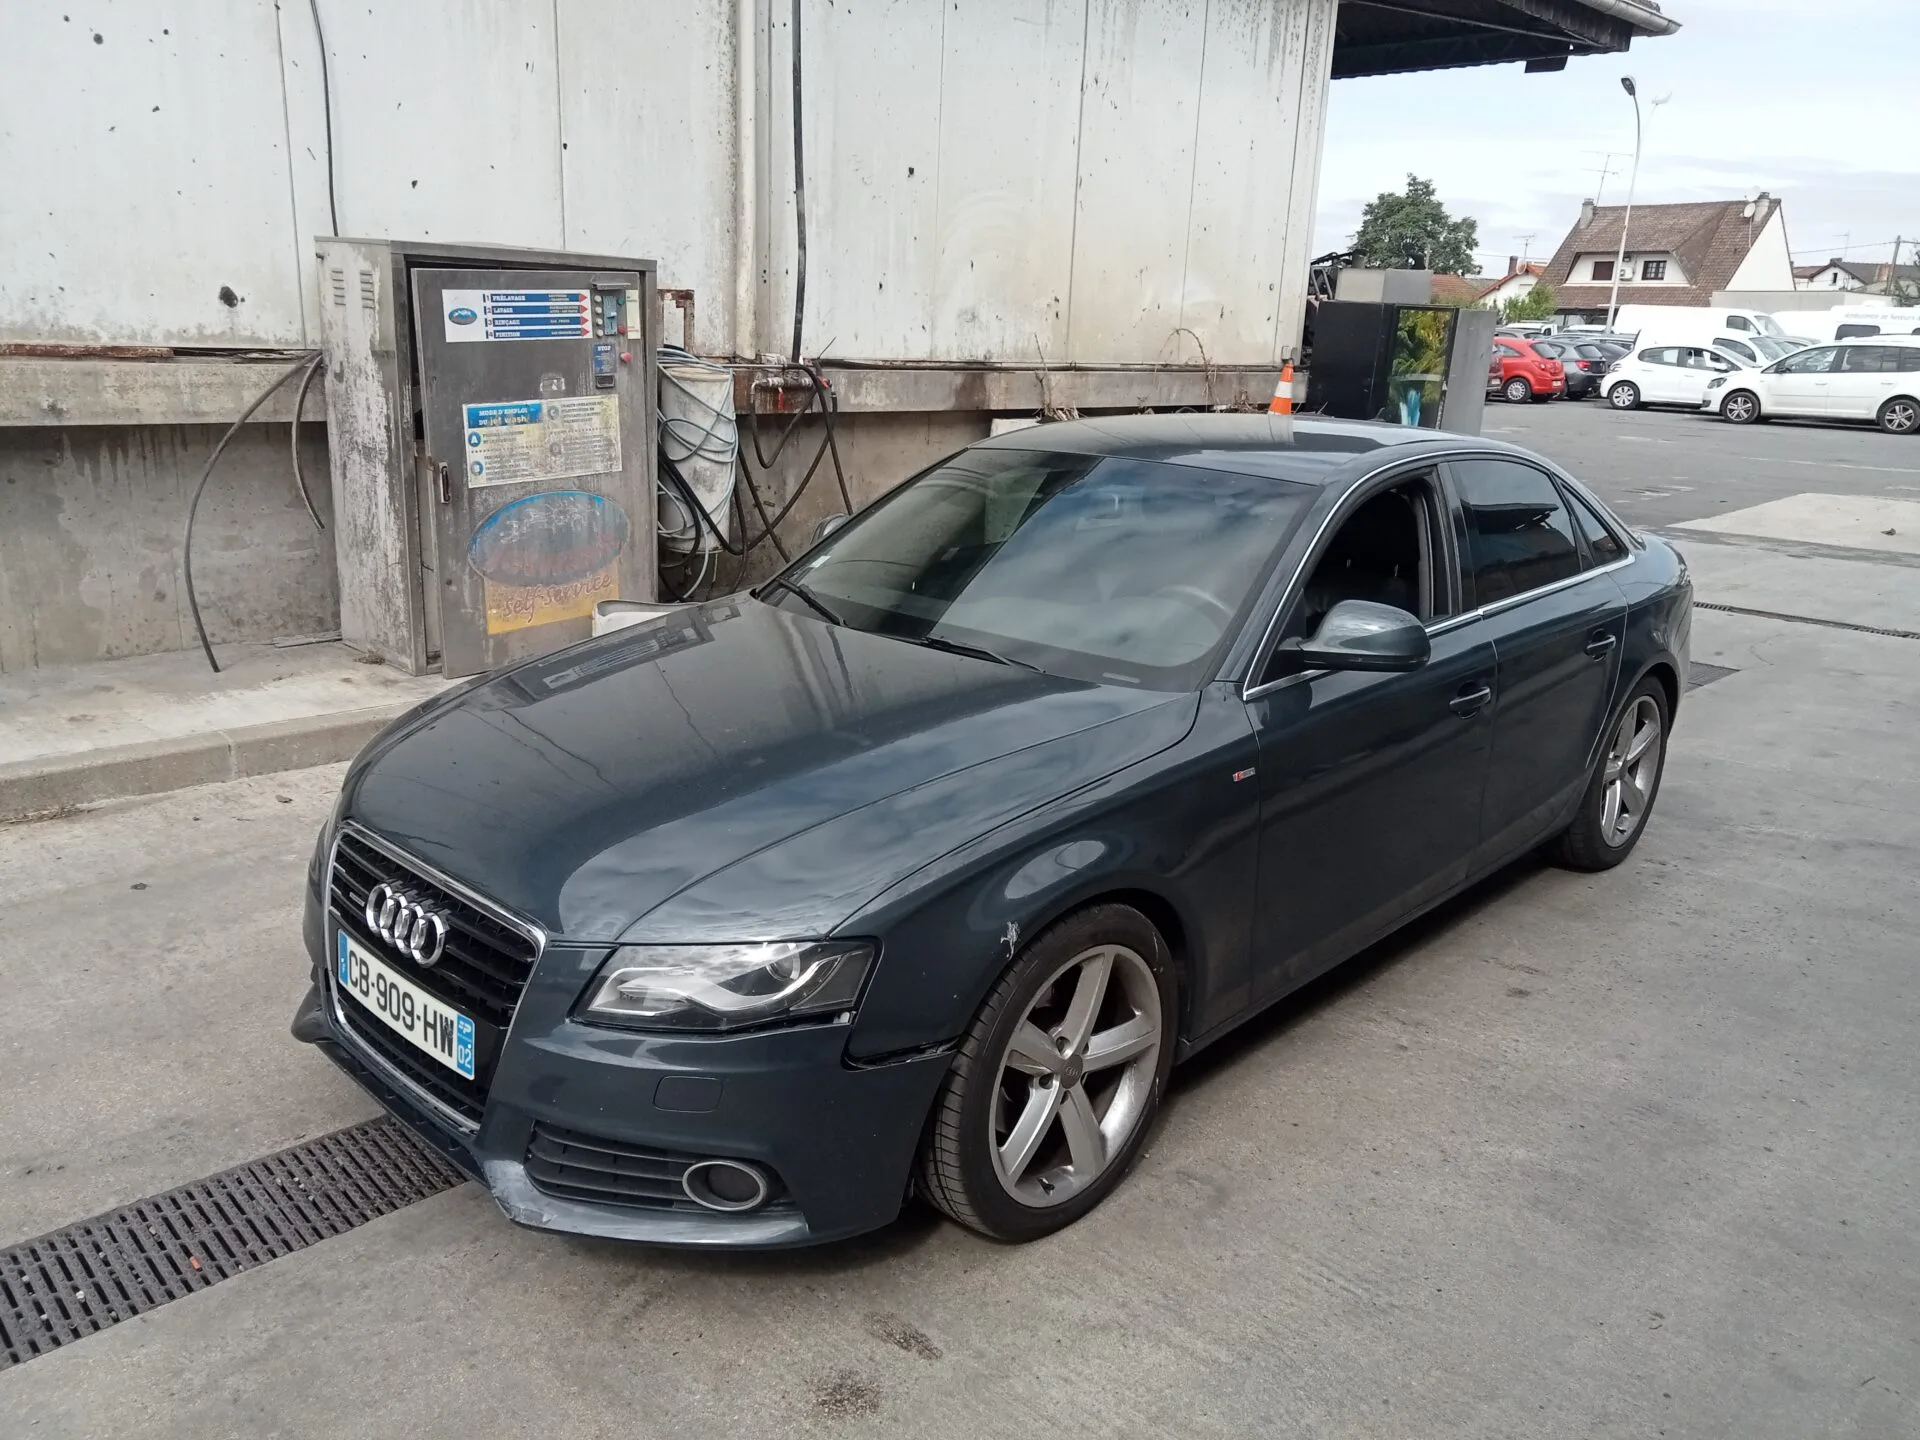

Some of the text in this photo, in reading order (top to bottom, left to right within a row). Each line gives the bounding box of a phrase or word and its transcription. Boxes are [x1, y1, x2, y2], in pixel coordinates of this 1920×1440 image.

[493, 306, 513, 314] LAVAGE
[349, 949, 455, 1059] CB-909-HW
[458, 1044, 472, 1069] 02
